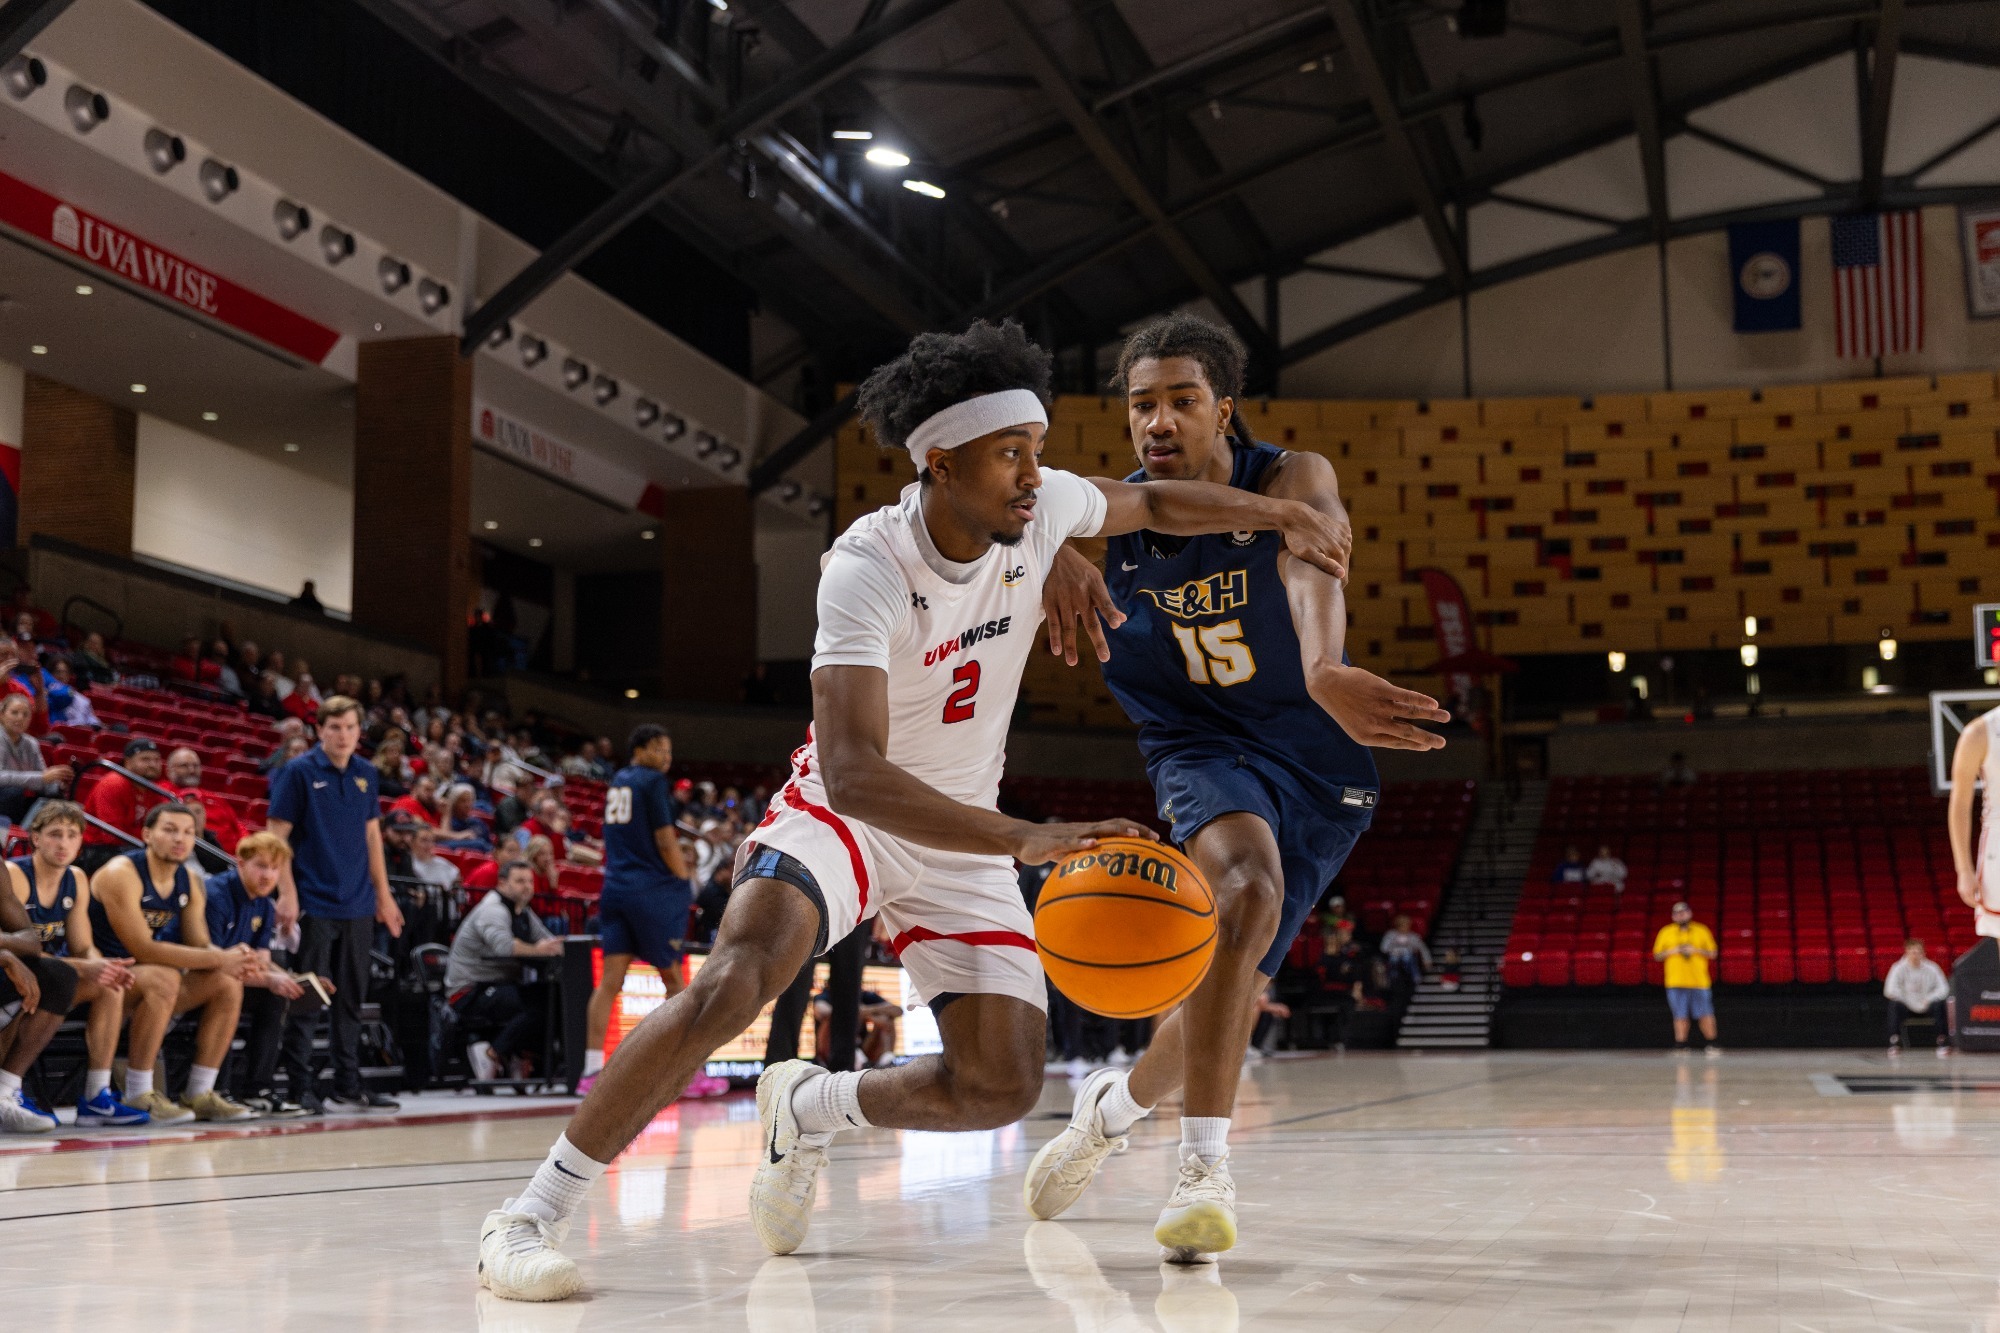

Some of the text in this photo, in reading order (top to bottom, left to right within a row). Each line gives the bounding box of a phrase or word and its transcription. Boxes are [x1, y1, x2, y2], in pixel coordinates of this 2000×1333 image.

[1004, 566, 1025, 583] SAC
[1146, 569, 1248, 619] E&H
[1171, 619, 1257, 687] 15
[942, 660, 981, 724] 2
[605, 786, 632, 824] 20
[1364, 795, 1373, 804] XL
[1058, 851, 1178, 895] Wilson
